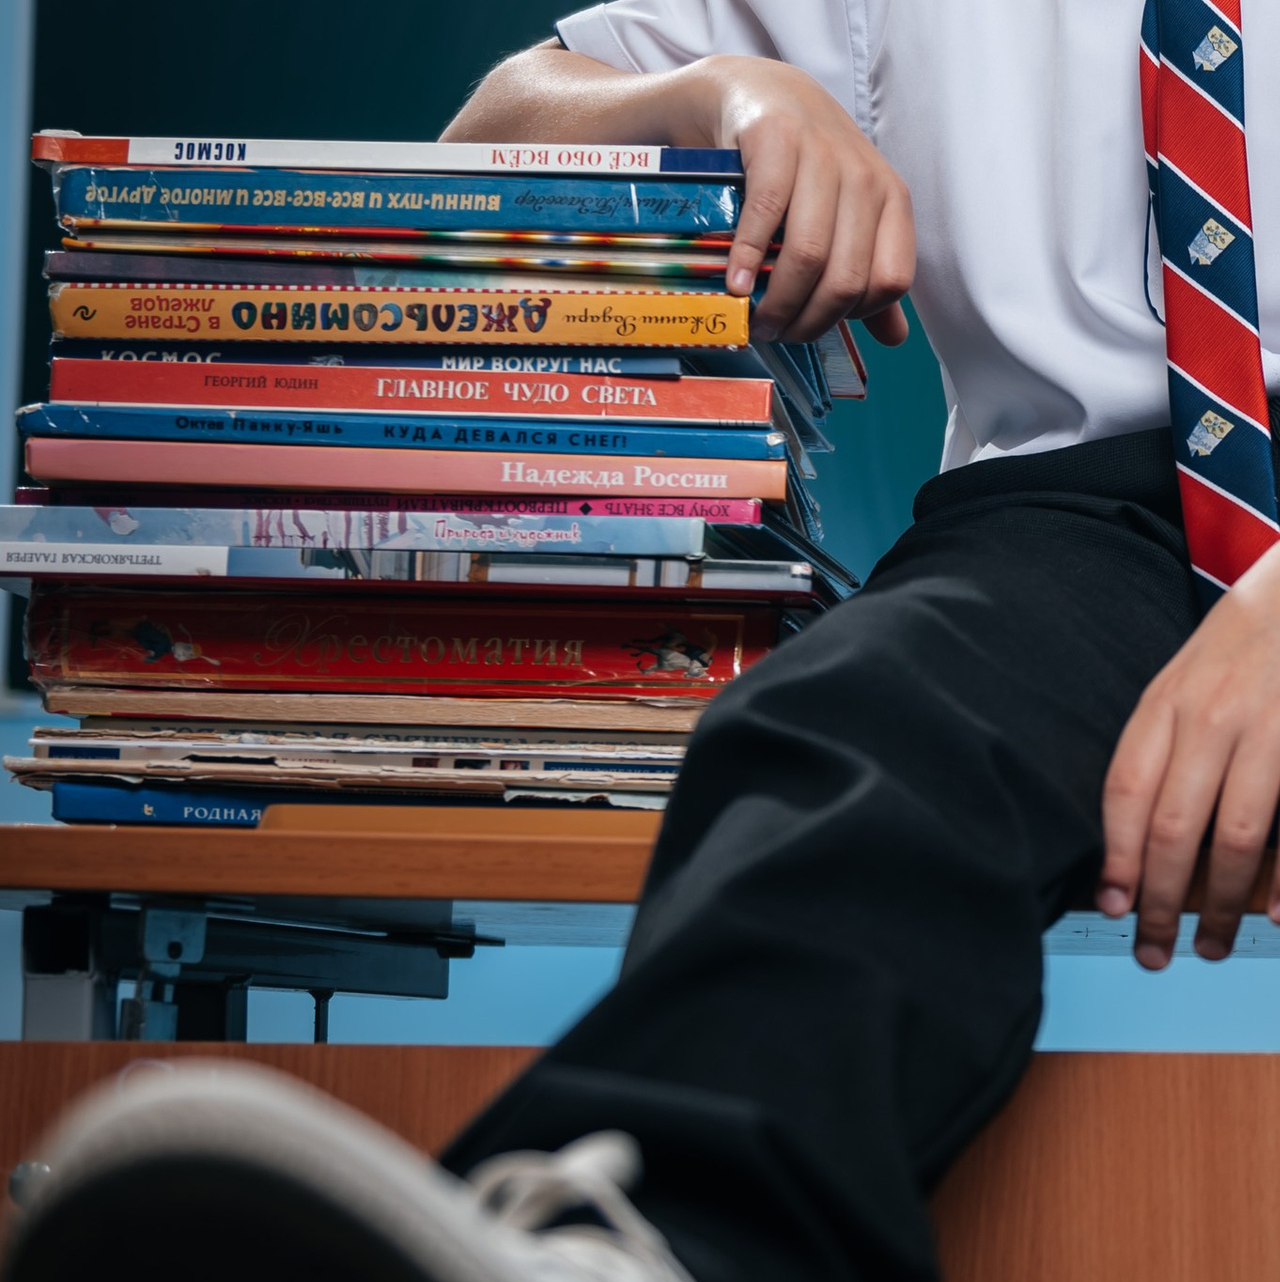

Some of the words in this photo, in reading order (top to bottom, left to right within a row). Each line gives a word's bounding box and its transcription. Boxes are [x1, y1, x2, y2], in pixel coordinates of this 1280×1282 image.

[174, 142, 246, 161] КОСМОС
[491, 149, 549, 168] ВСЁМ
[557, 150, 601, 166] ОБО
[608, 151, 650, 170] ВСЁ
[232, 298, 552, 333] ДЖЕЛЬСОМИНО
[565, 306, 637, 336] Родари
[642, 313, 727, 335] Джанни
[442, 357, 485, 371] МИР
[492, 357, 572, 373] ВОКРУГ
[580, 358, 622, 374] НАС
[204, 374, 267, 388] ГЕОРГИЙ
[274, 377, 319, 391] ЮДИН
[376, 378, 489, 400] ГЛАВНОЕ
[503, 382, 569, 404] ЧУДО
[581, 384, 657, 406] СВЕТА
[175, 416, 224, 431] Октав
[383, 424, 443, 442] КУДА
[454, 427, 557, 445] ДЕВАЛСЯ
[501, 461, 625, 488] Надежда
[632, 466, 728, 489] России
[397, 497, 568, 514] ПЕРВООТКРЫВАТЕЛИ
[605, 503, 654, 516] ЗНАТЬ
[658, 504, 684, 516] ВСЕ
[689, 504, 730, 517] ХОЧУ
[435, 520, 494, 544] Природа
[6, 552, 57, 564] ГАЛЕРЕЯ
[62, 553, 162, 565] ТРЕТЬЯКОВСКАЯ
[184, 806, 262, 821] РОДНАЯ
